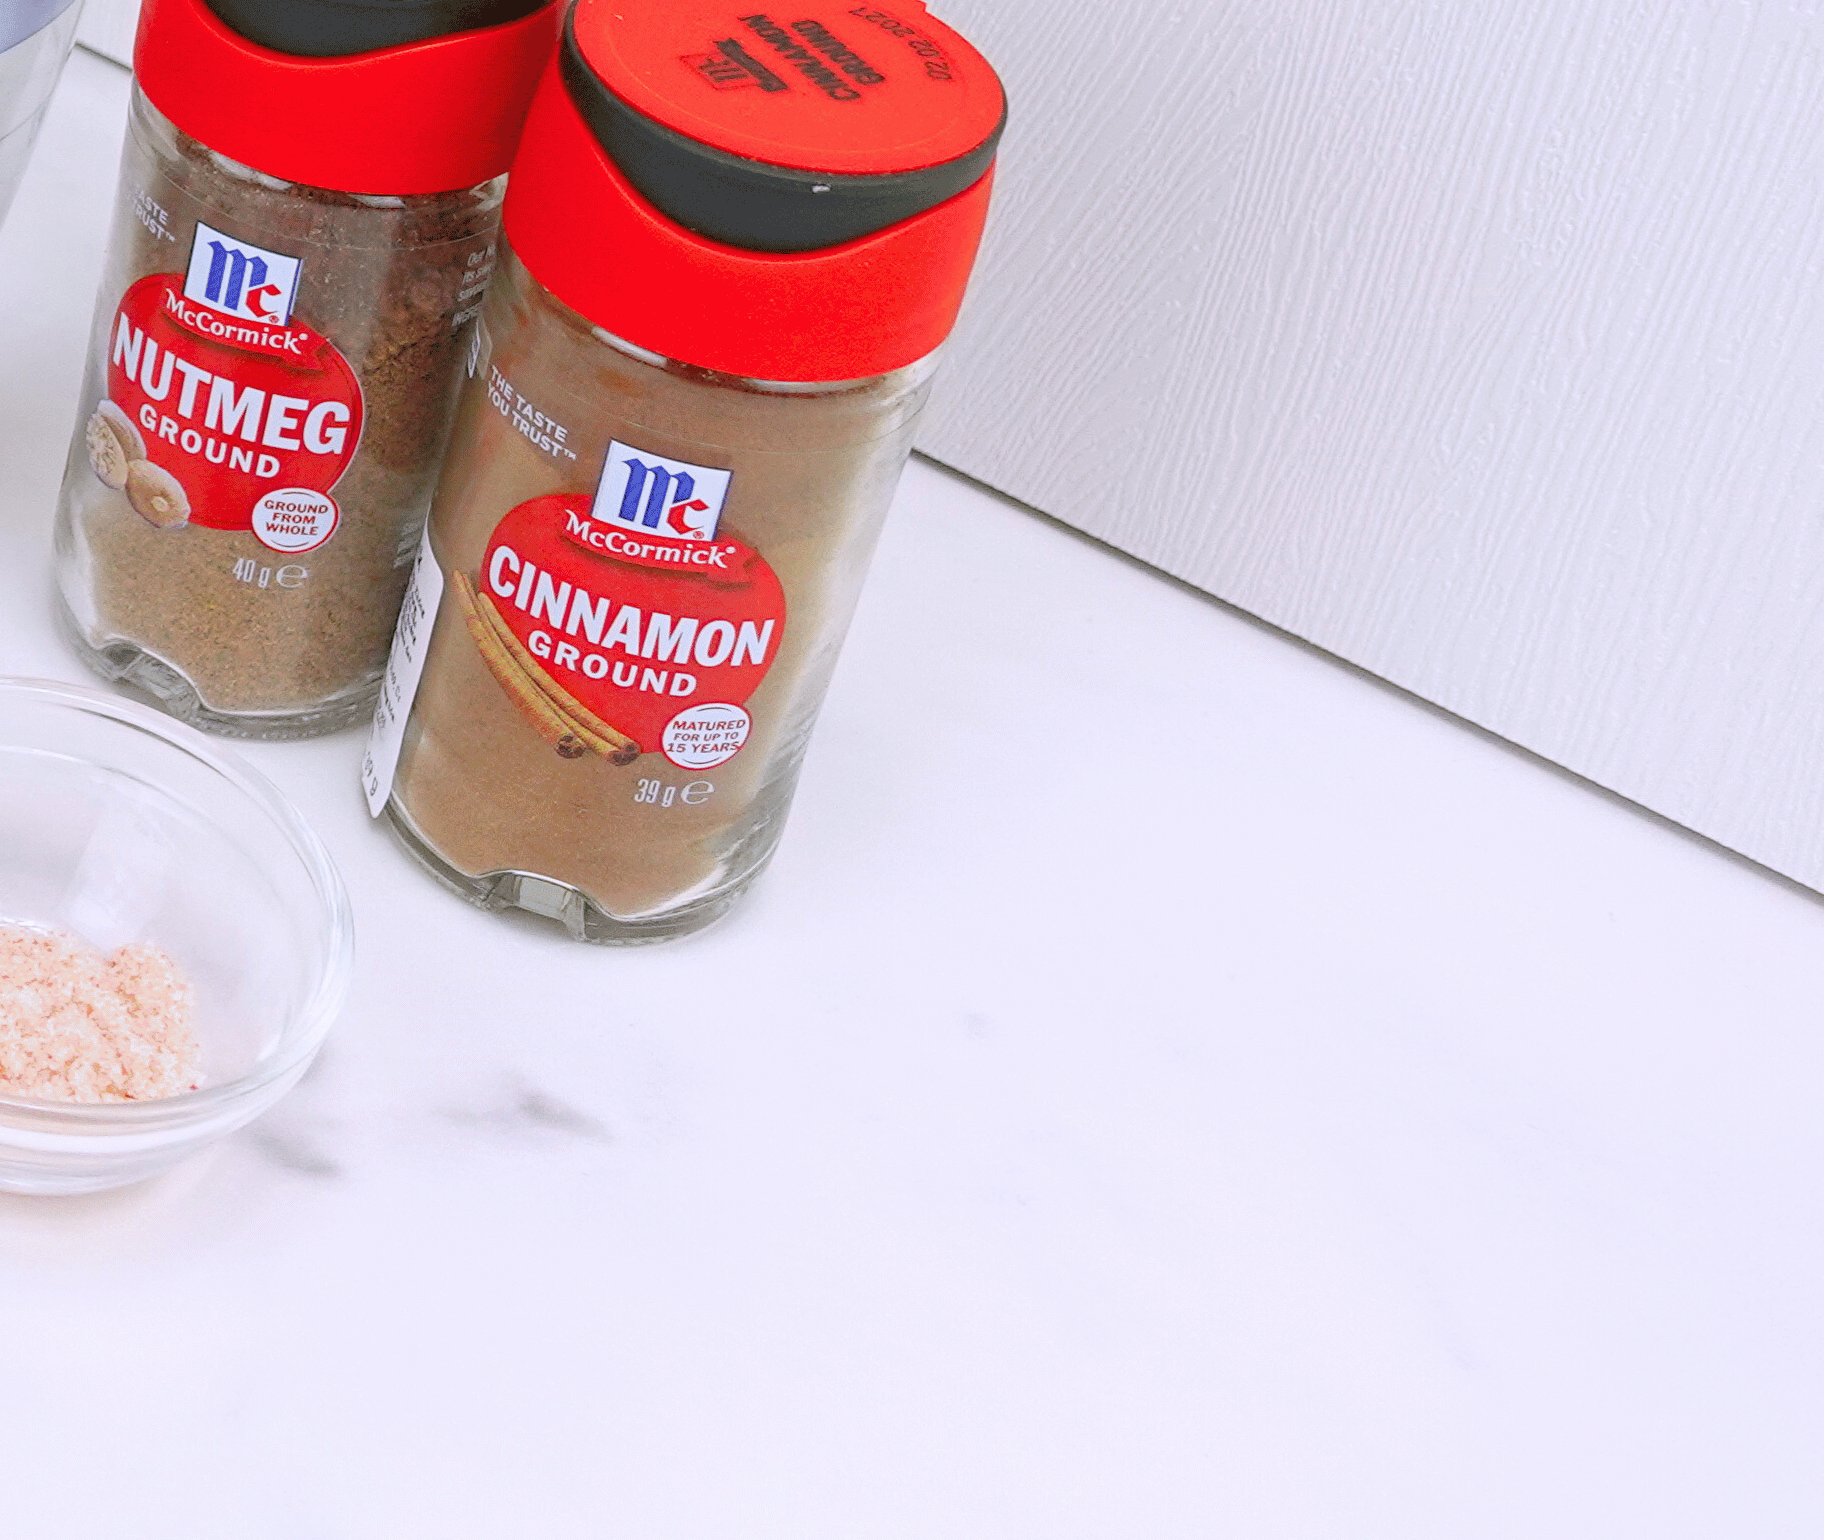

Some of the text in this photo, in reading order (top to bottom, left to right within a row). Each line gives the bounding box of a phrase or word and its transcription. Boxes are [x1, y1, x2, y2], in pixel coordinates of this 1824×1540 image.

[164, 287, 308, 355] McCormick
[113, 312, 350, 456] NUTMEG
[488, 380, 511, 417] YOU
[491, 365, 569, 444] THE TASTE
[139, 408, 280, 478] GROUND
[264, 499, 329, 514] GROUND
[272, 512, 317, 526] FROM
[265, 521, 319, 536] WHOLE
[565, 509, 736, 569] McCormick
[232, 557, 256, 583] 40
[257, 567, 272, 589] g
[488, 545, 776, 667] CINNAMON
[528, 629, 697, 697] GROUND
[672, 719, 746, 731] MATURED
[673, 731, 739, 742] FOR UP TO
[666, 741, 740, 754] 15 YEARS
[634, 778, 660, 804] 39
[660, 786, 676, 808] g
